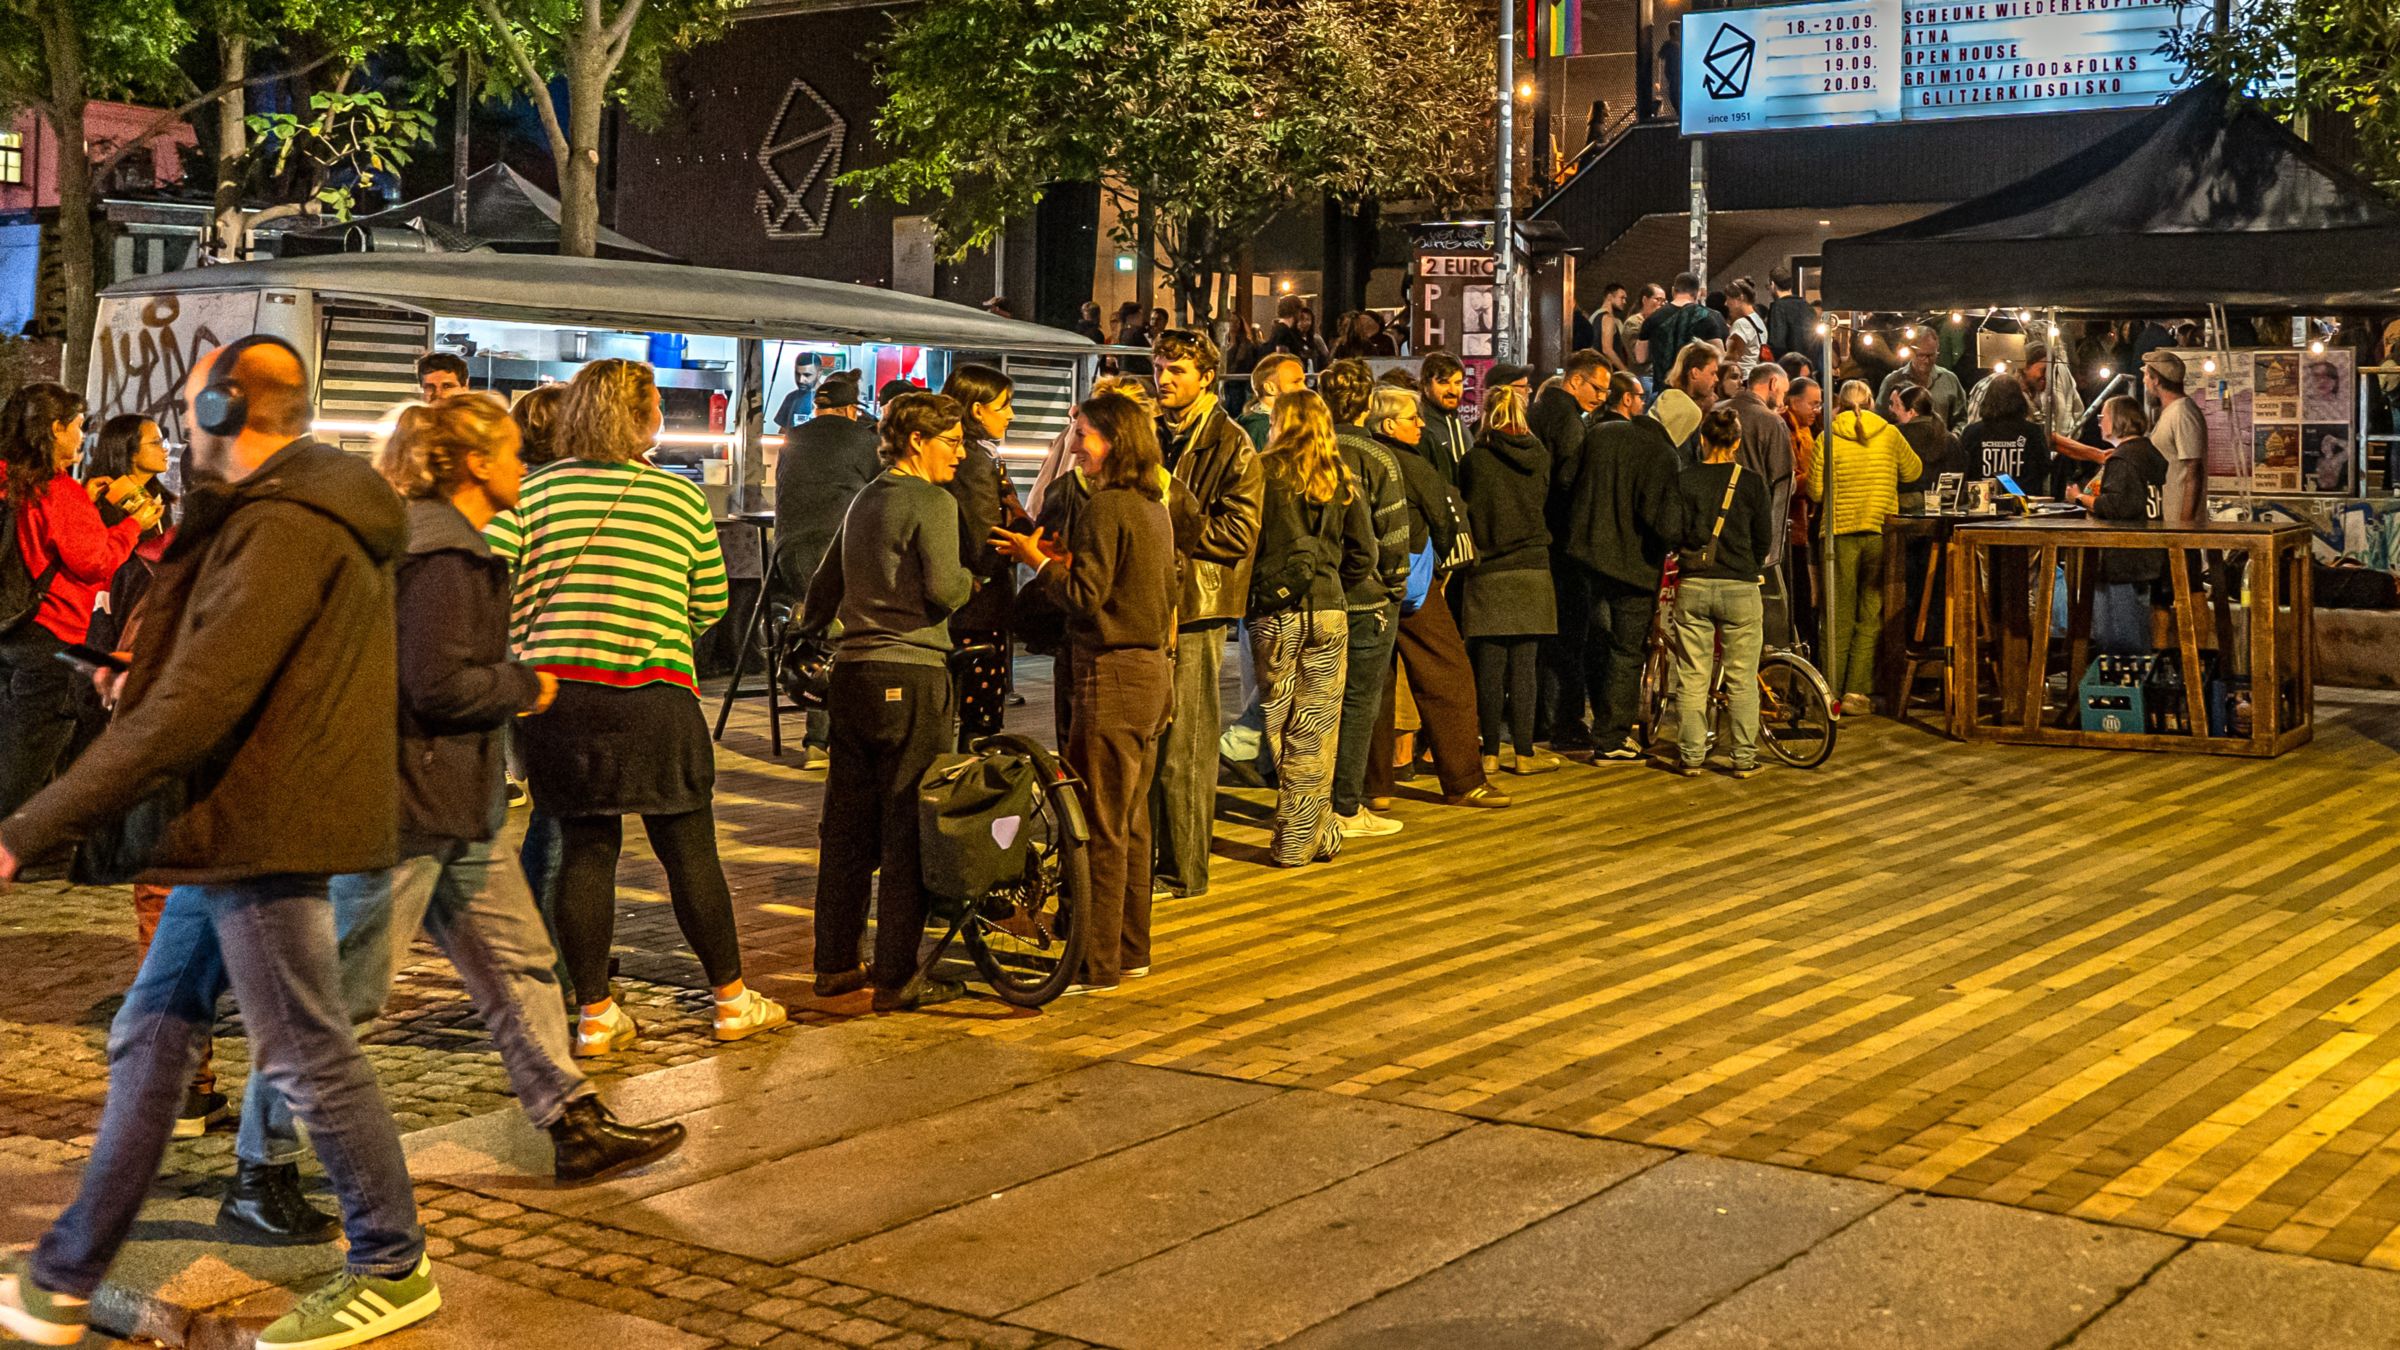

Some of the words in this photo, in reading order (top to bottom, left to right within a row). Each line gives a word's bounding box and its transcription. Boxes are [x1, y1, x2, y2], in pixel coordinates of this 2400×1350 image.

[1904, 5, 1985, 25] SCHEUNE
[1786, 15, 1878, 35] 18.-20.09.
[1825, 35, 1877, 52] 18.09.
[1904, 29, 1949, 46] ÄTNA
[1825, 55, 1877, 72] 19.09.
[1904, 48, 1949, 66] OPEN
[1959, 44, 2017, 62] HOUSE
[1904, 66, 1986, 86] GRIM104
[2013, 56, 2137, 79] FOOD&FOLKS
[1824, 75, 1876, 92] 20.09.
[1707, 113, 1729, 124] since
[1731, 111, 1751, 122] 1951
[1426, 258, 1437, 275] 2
[1981, 440, 2017, 448] SCHEUNE
[1982, 447, 2025, 477] STAFF
